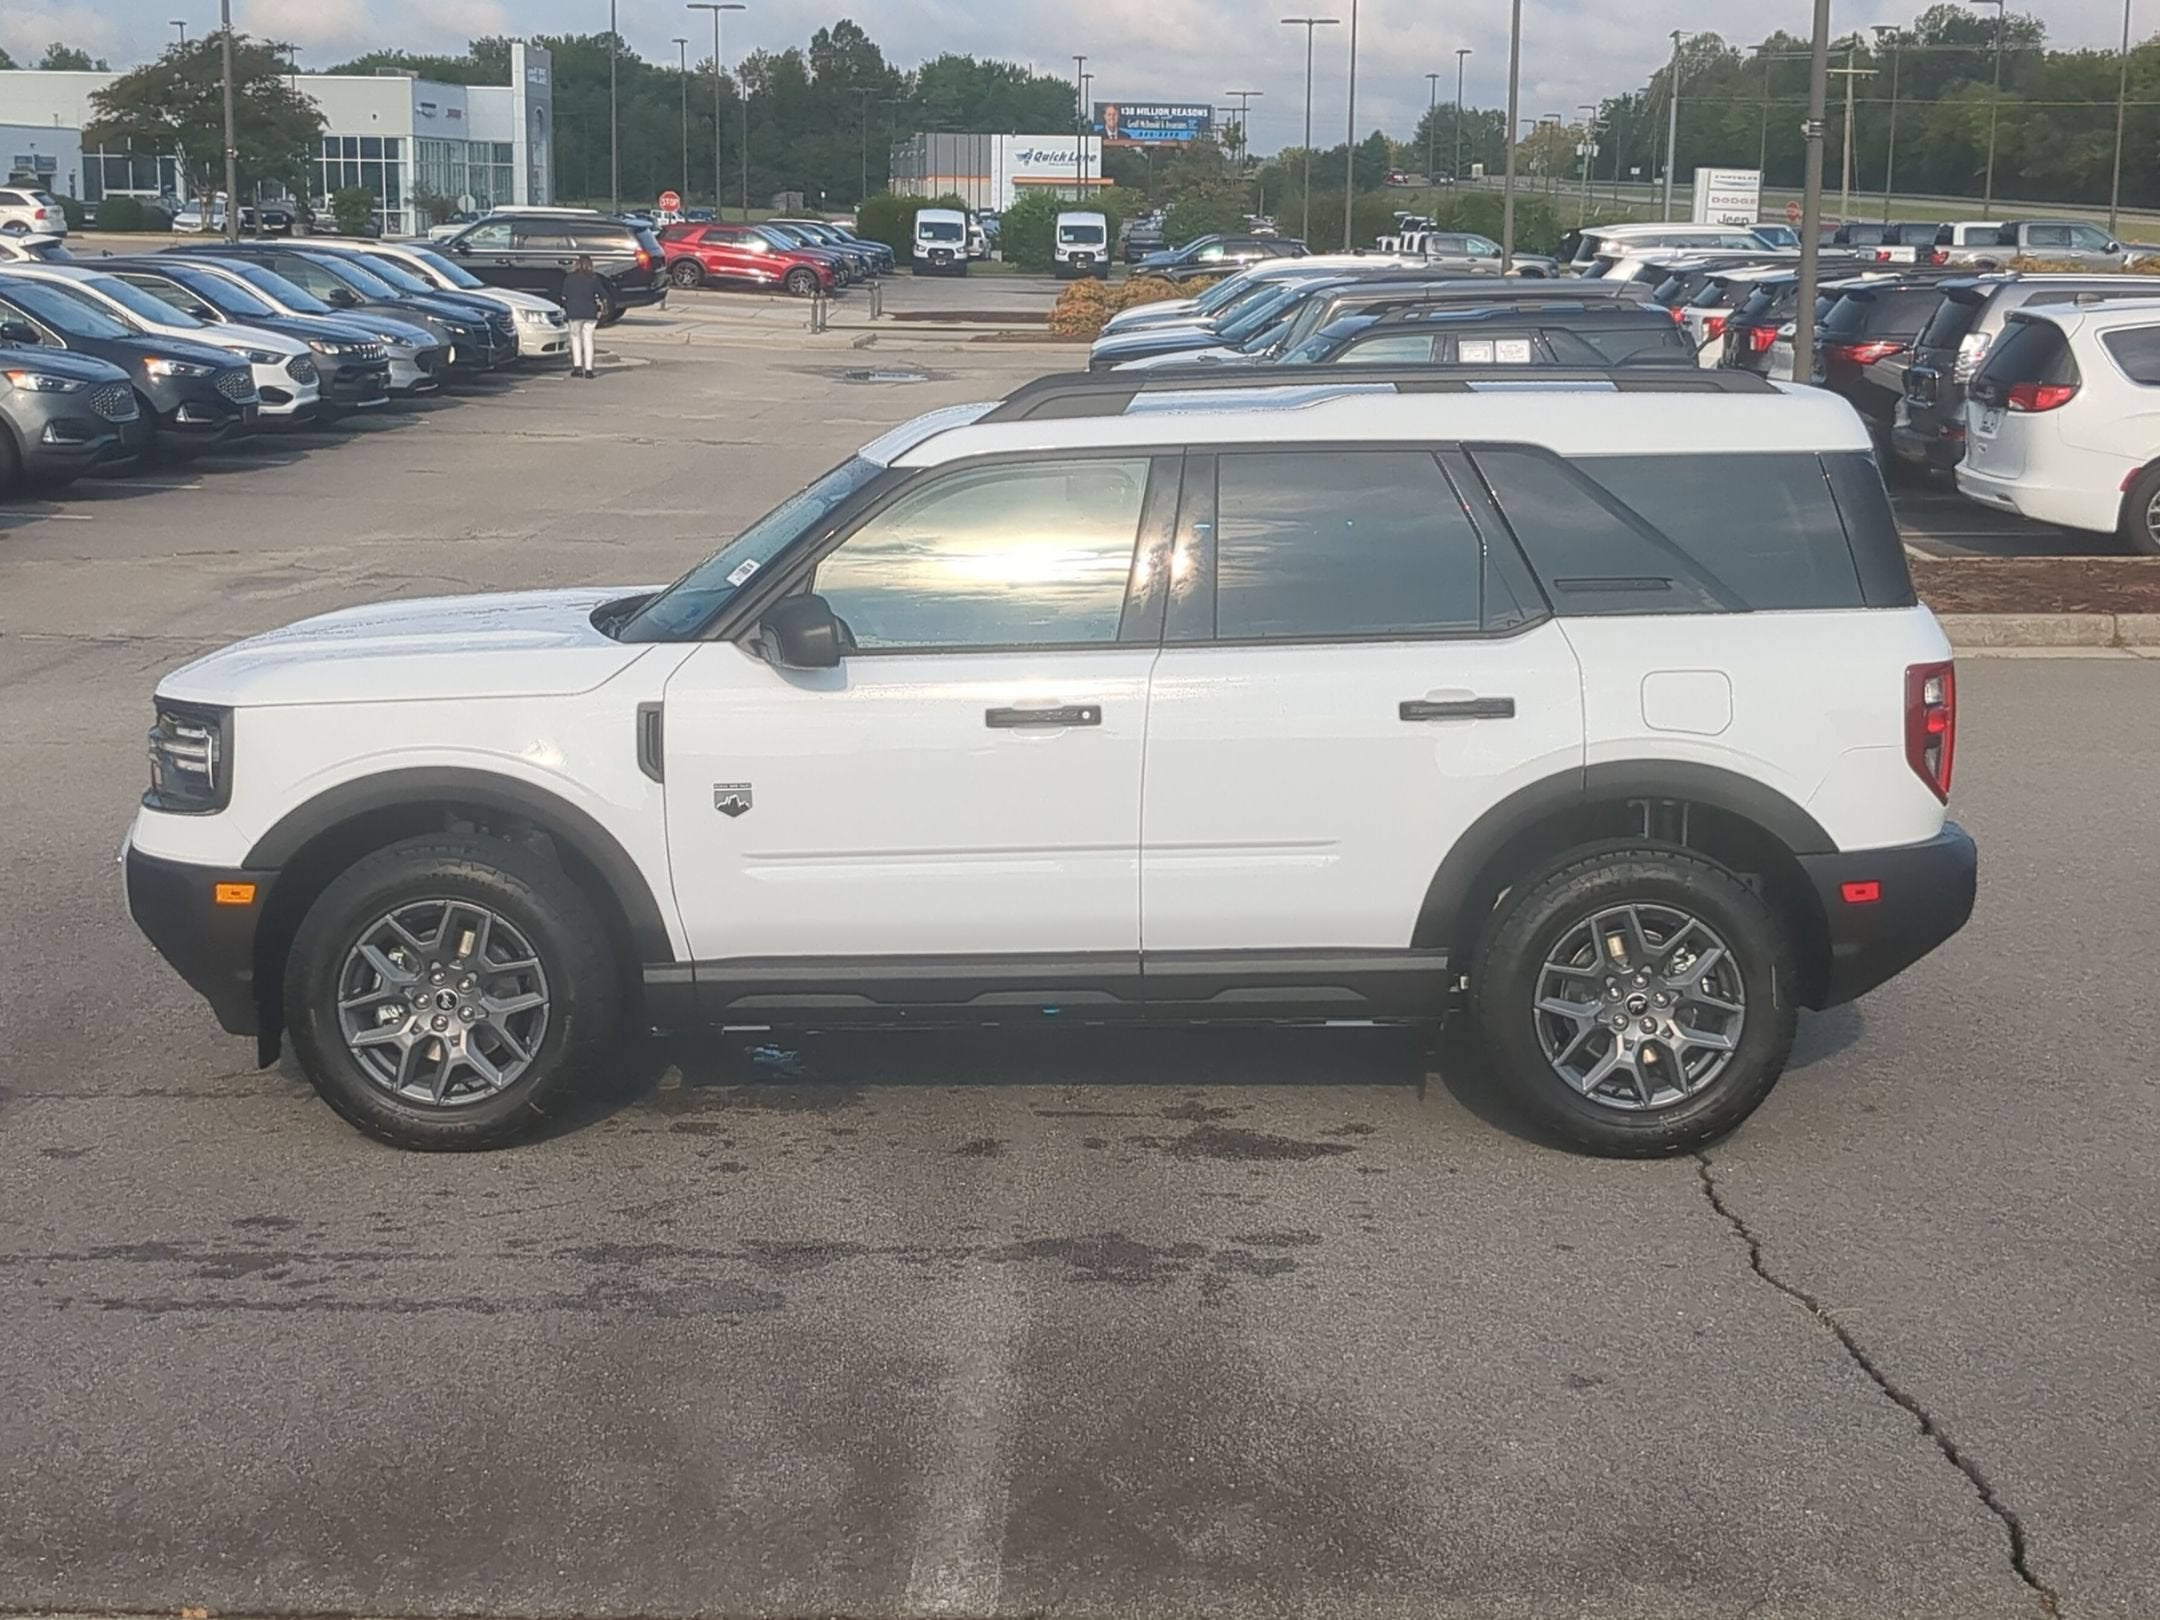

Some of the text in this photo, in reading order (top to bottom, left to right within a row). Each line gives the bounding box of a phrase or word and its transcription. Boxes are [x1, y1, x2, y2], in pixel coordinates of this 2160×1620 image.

[1136, 107, 1170, 116] MILLION
[1171, 108, 1208, 117] REASONS
[1033, 151, 1068, 163] Quick
[662, 198, 679, 206] STOP
[1712, 197, 1756, 205] DODGE
[1716, 213, 1750, 225] Jeep
